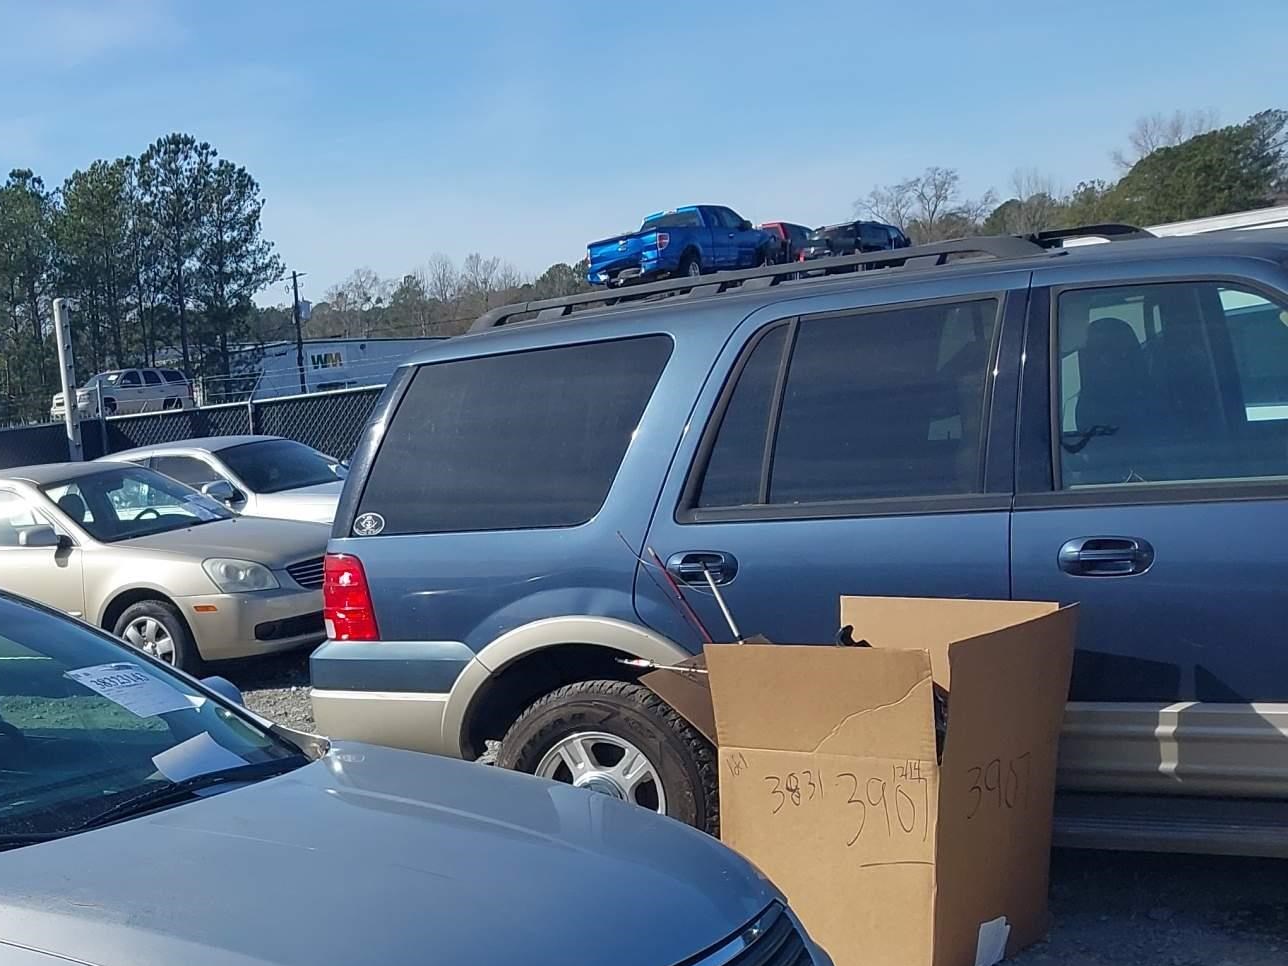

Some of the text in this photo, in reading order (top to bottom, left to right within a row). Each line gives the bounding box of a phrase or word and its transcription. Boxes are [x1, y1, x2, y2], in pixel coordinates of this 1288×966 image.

[89, 671, 150, 690] 38323143
[764, 767, 929, 847] 3831 3907
